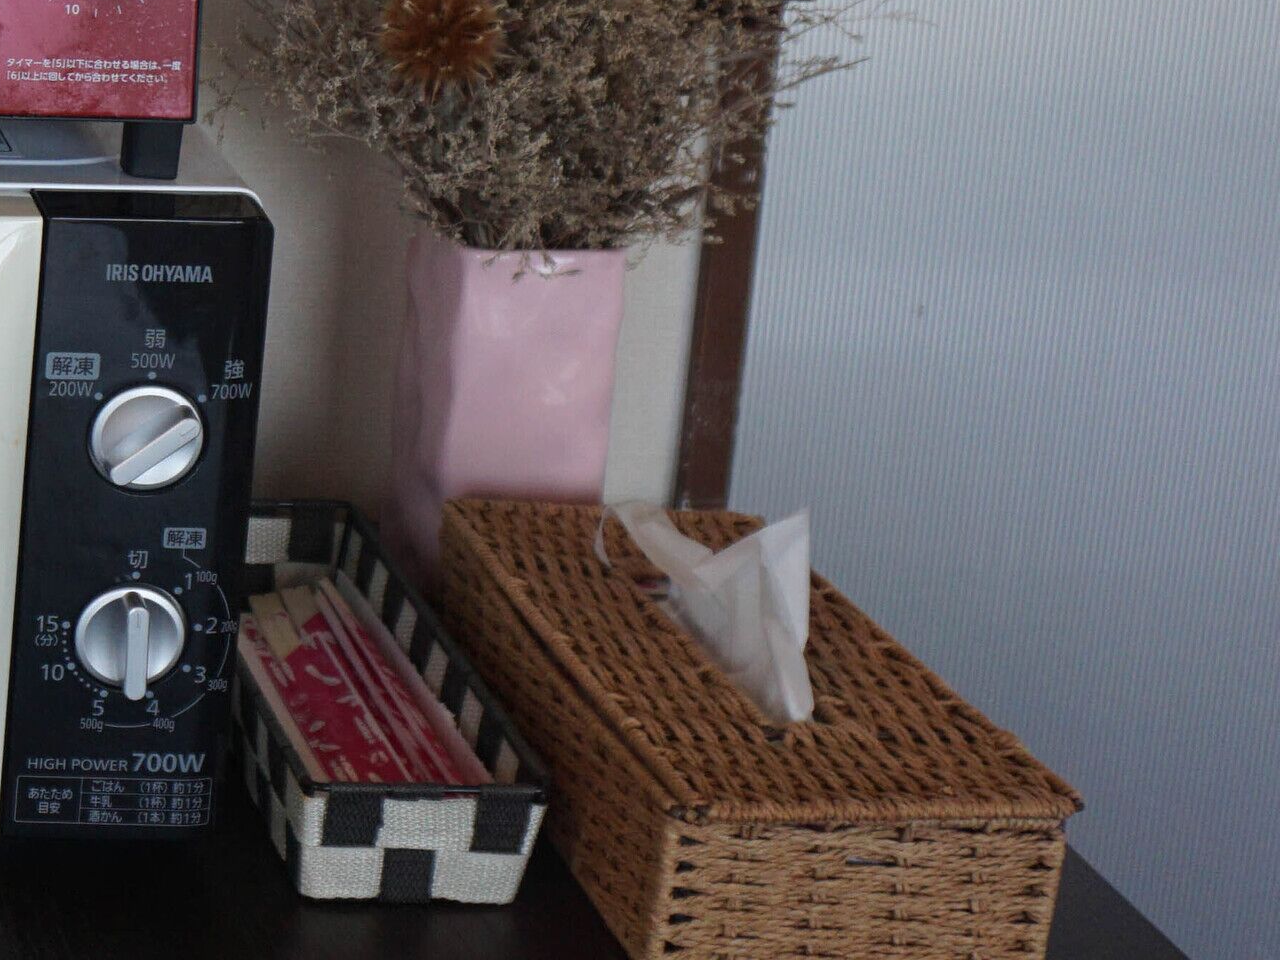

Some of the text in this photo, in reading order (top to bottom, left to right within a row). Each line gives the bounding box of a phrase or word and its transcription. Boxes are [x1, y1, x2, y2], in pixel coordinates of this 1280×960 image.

[65, 5, 80, 15] 10
[106, 264, 213, 283] IRIS OHYAMA
[145, 329, 166, 348] 弱
[51, 356, 95, 375] 解凍
[131, 353, 175, 369] 500W
[225, 360, 244, 379] 強
[49, 382, 93, 397] 200W
[211, 383, 252, 399] 700W
[167, 531, 203, 546] 解凍
[128, 551, 149, 569] 切
[196, 571, 218, 585] 100g
[36, 616, 58, 631] 15
[206, 617, 217, 634] 2
[41, 664, 64, 681] 10
[194, 666, 207, 683] 3
[92, 700, 104, 716] 5
[146, 700, 159, 715] 4
[80, 718, 103, 732] 500g
[152, 717, 175, 731] 400g
[28, 753, 205, 773] HIGH POWER 700W
[38, 802, 60, 814] 目安
